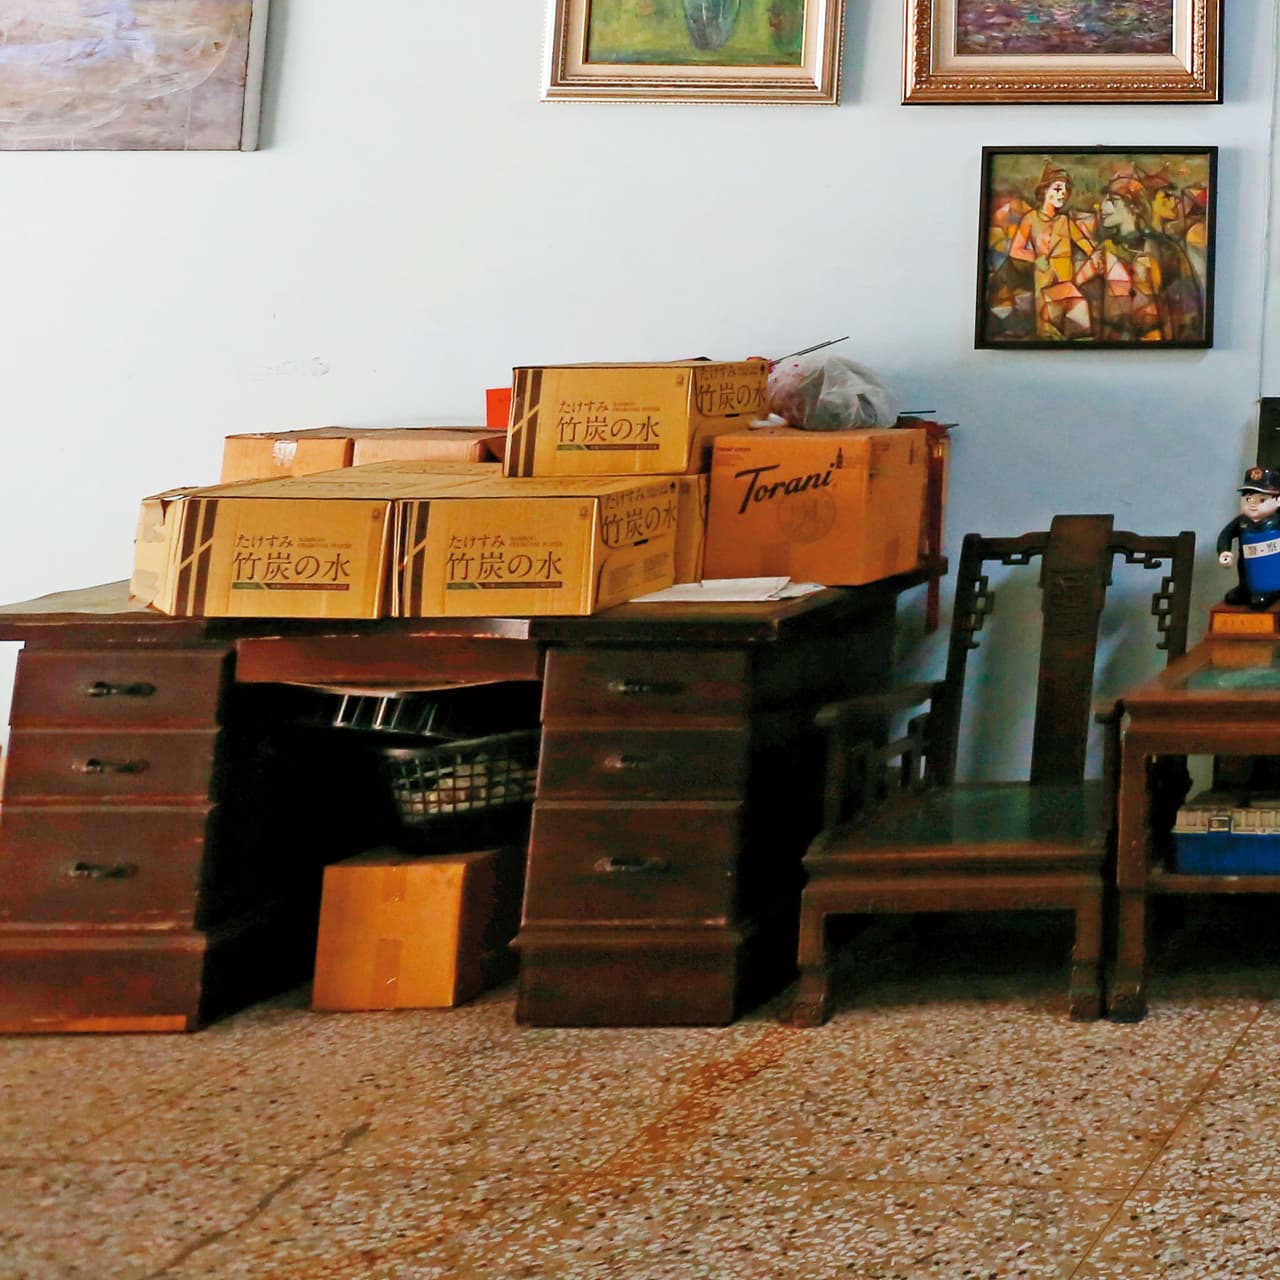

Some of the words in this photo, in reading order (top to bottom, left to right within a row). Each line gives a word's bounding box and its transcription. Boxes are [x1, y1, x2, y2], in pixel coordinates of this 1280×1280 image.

[559, 400, 608, 413] たけすみ
[700, 380, 767, 412] 竹炭の水
[556, 416, 660, 442] 竹炭の水
[734, 464, 835, 514] Torani
[602, 501, 677, 545] 竹炭の水
[237, 534, 294, 549] たけすみ
[448, 535, 504, 549] たけすみ
[232, 552, 351, 582] 竹炭の水
[447, 551, 563, 580] 竹炭の水
